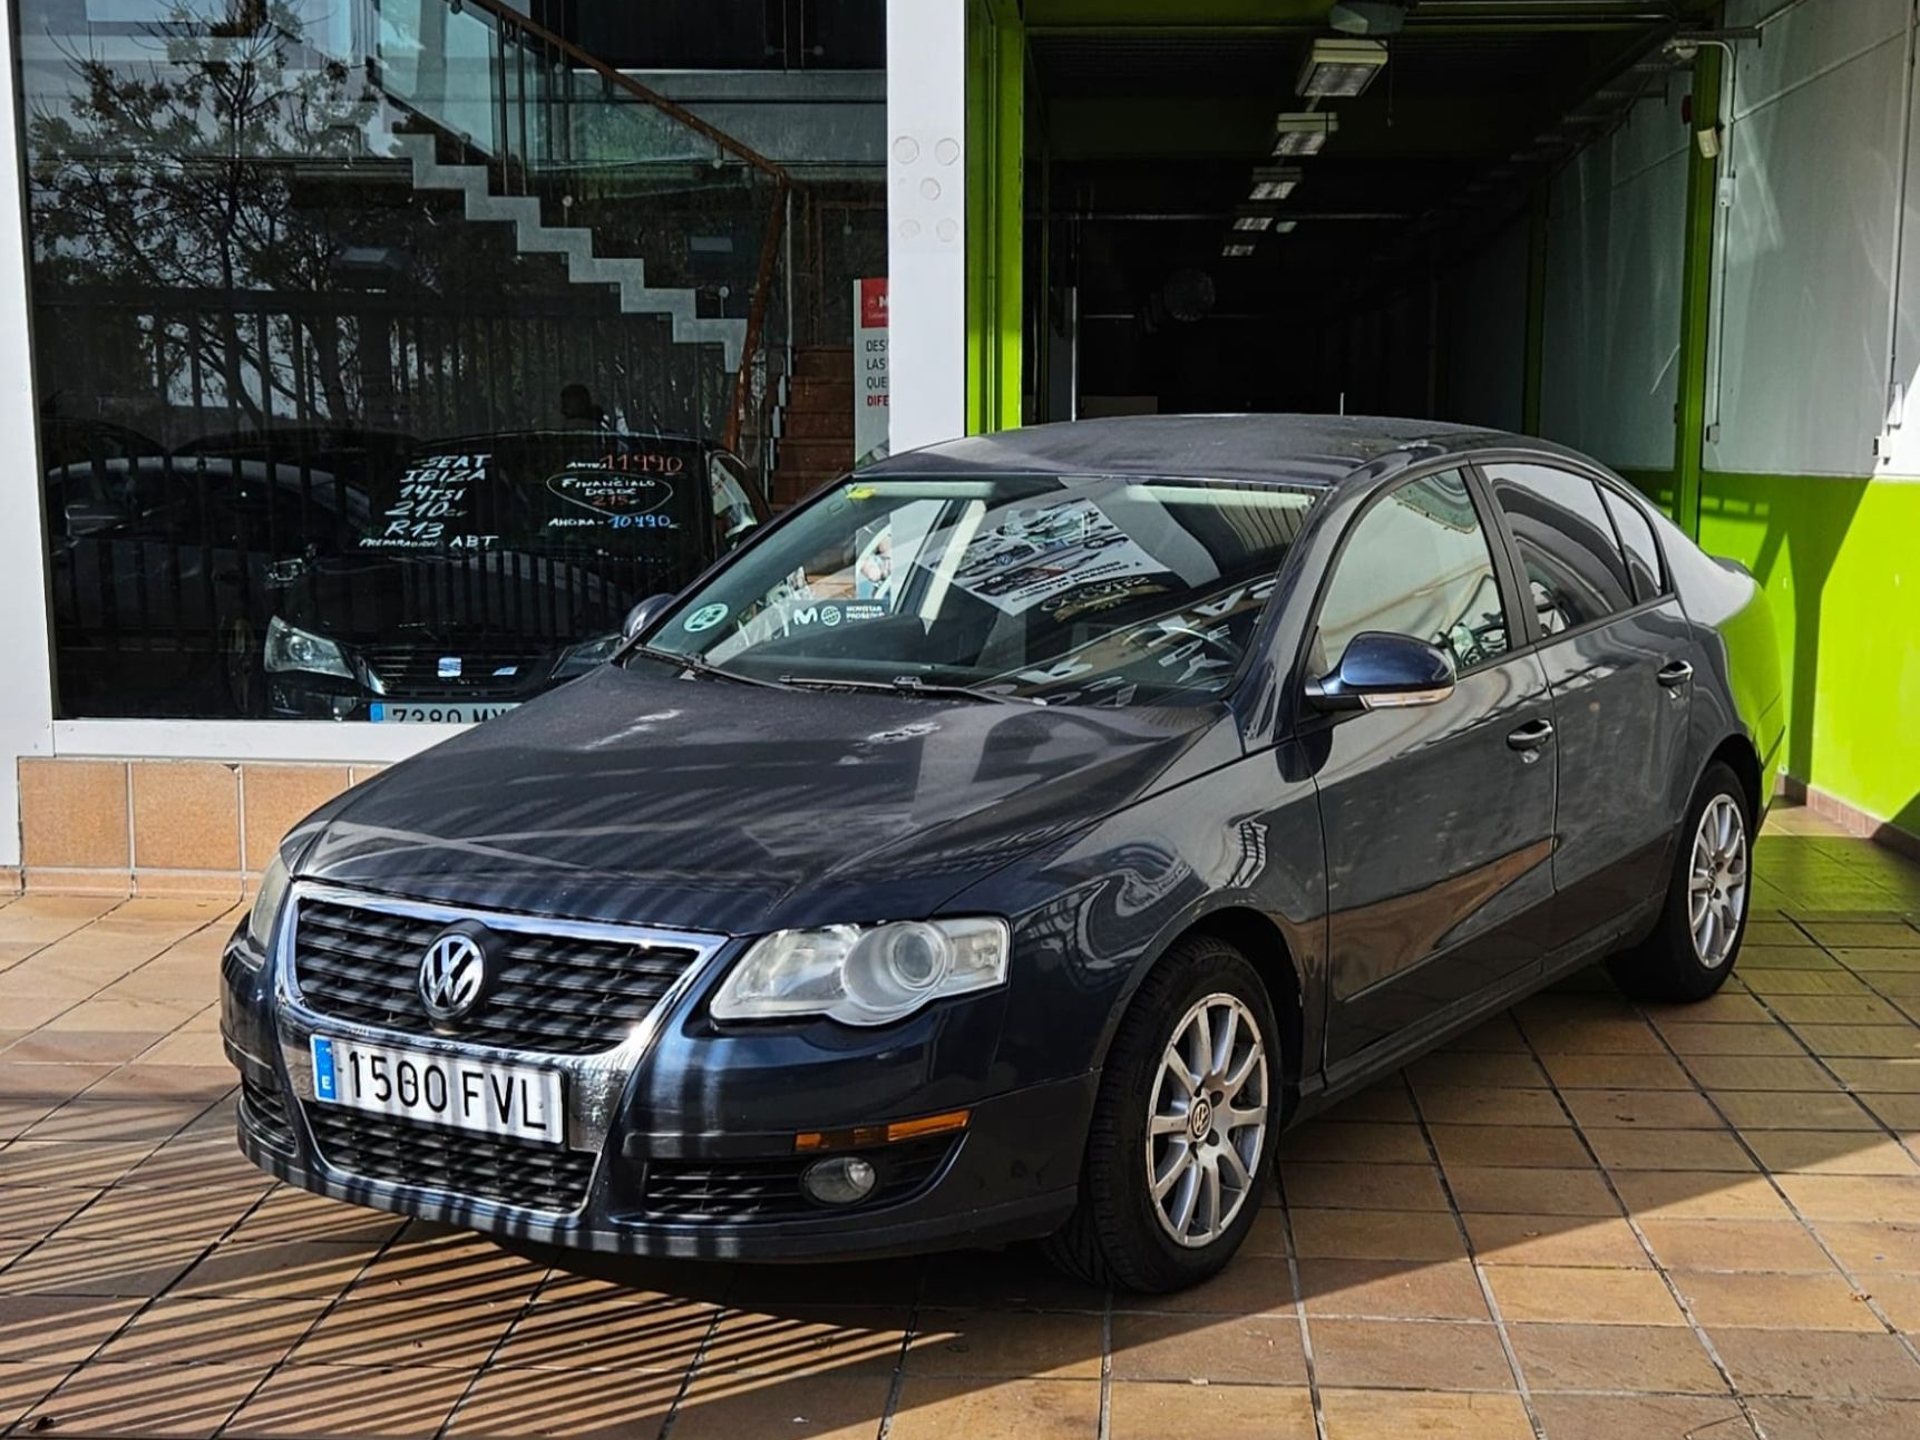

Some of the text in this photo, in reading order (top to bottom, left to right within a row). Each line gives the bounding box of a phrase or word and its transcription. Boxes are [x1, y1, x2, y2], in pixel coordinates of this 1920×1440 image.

[866, 358, 886, 371] LAS
[866, 376, 888, 389] QUE
[421, 454, 492, 469] SEAT
[400, 467, 486, 483] IBIZA
[449, 534, 499, 548] ABT
[462, 1070, 547, 1131] FVL
